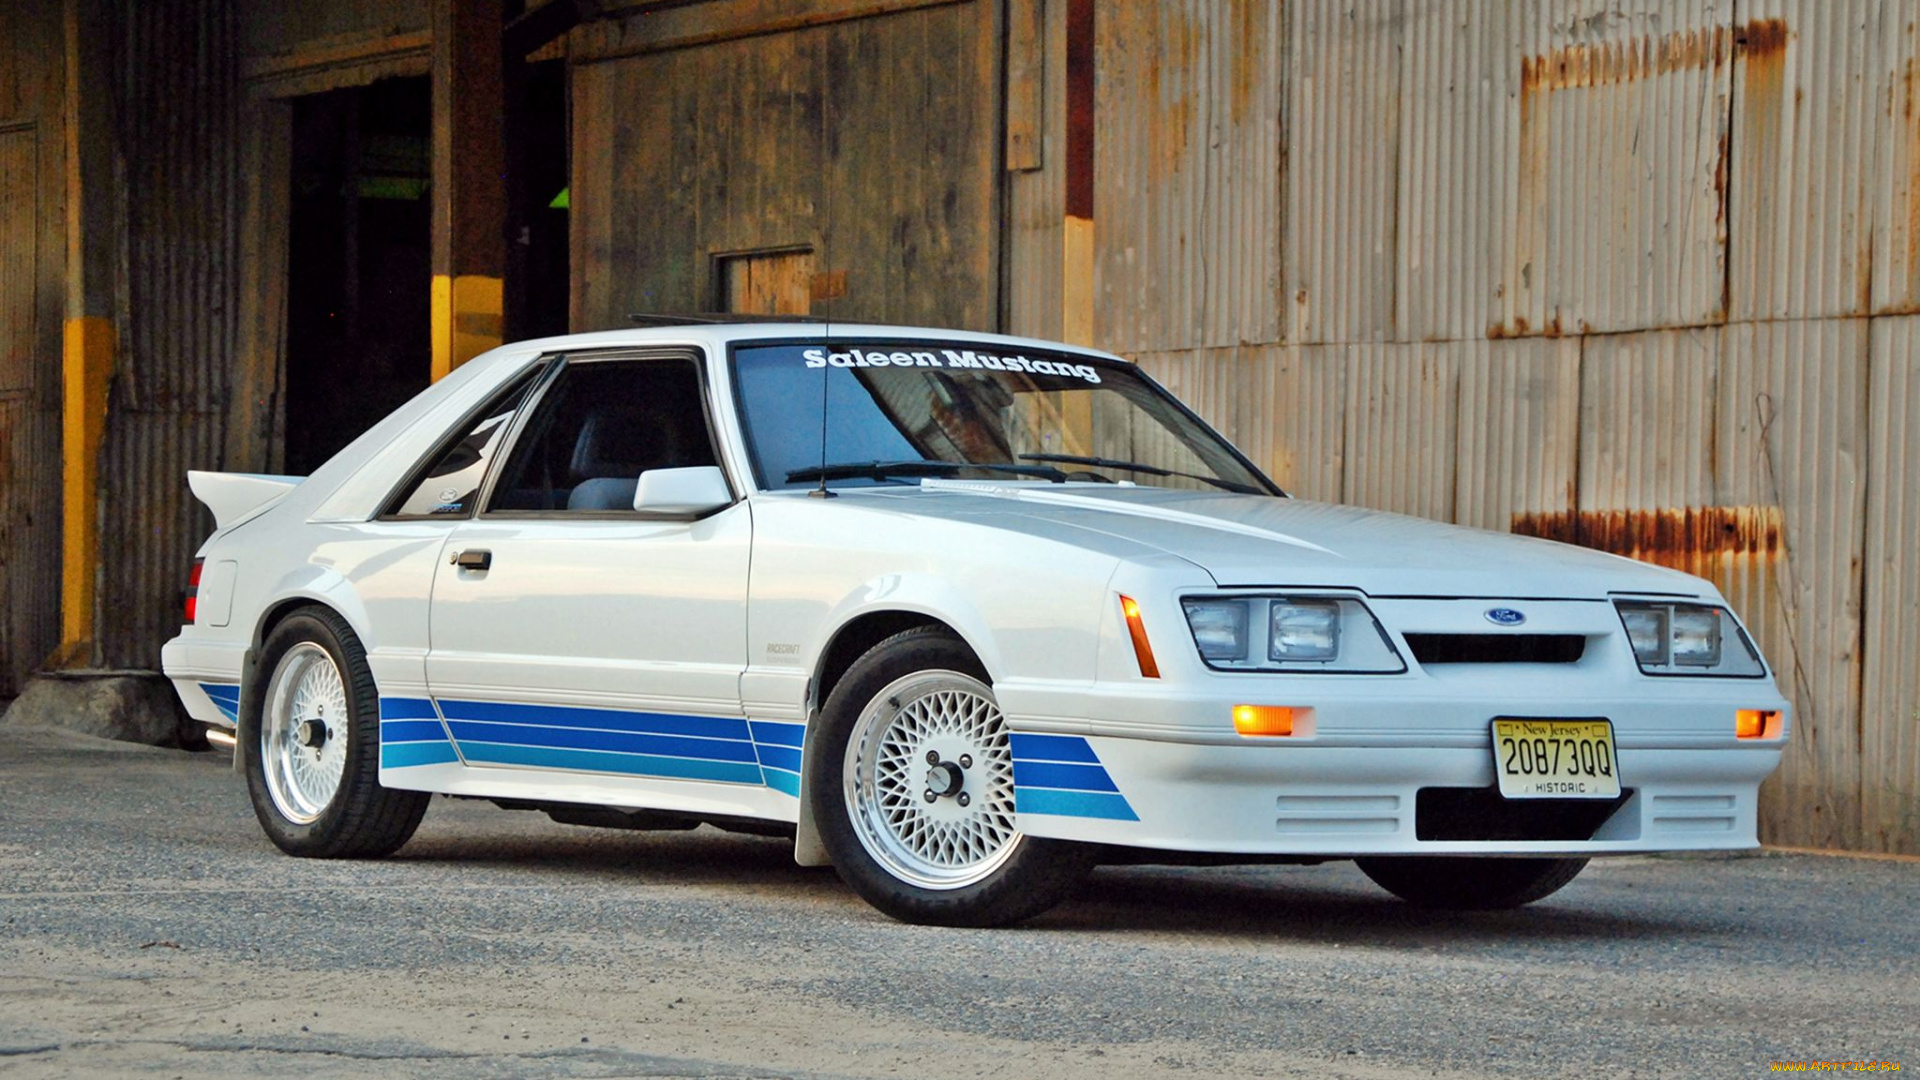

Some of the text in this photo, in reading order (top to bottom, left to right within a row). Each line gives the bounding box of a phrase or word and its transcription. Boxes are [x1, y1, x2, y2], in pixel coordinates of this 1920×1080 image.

[803, 349, 1101, 384] Saleen Mustang
[1522, 723, 1581, 737] New Jersey
[1503, 738, 1611, 777] 20873QQ
[1535, 782, 1586, 793] HISTORIC
